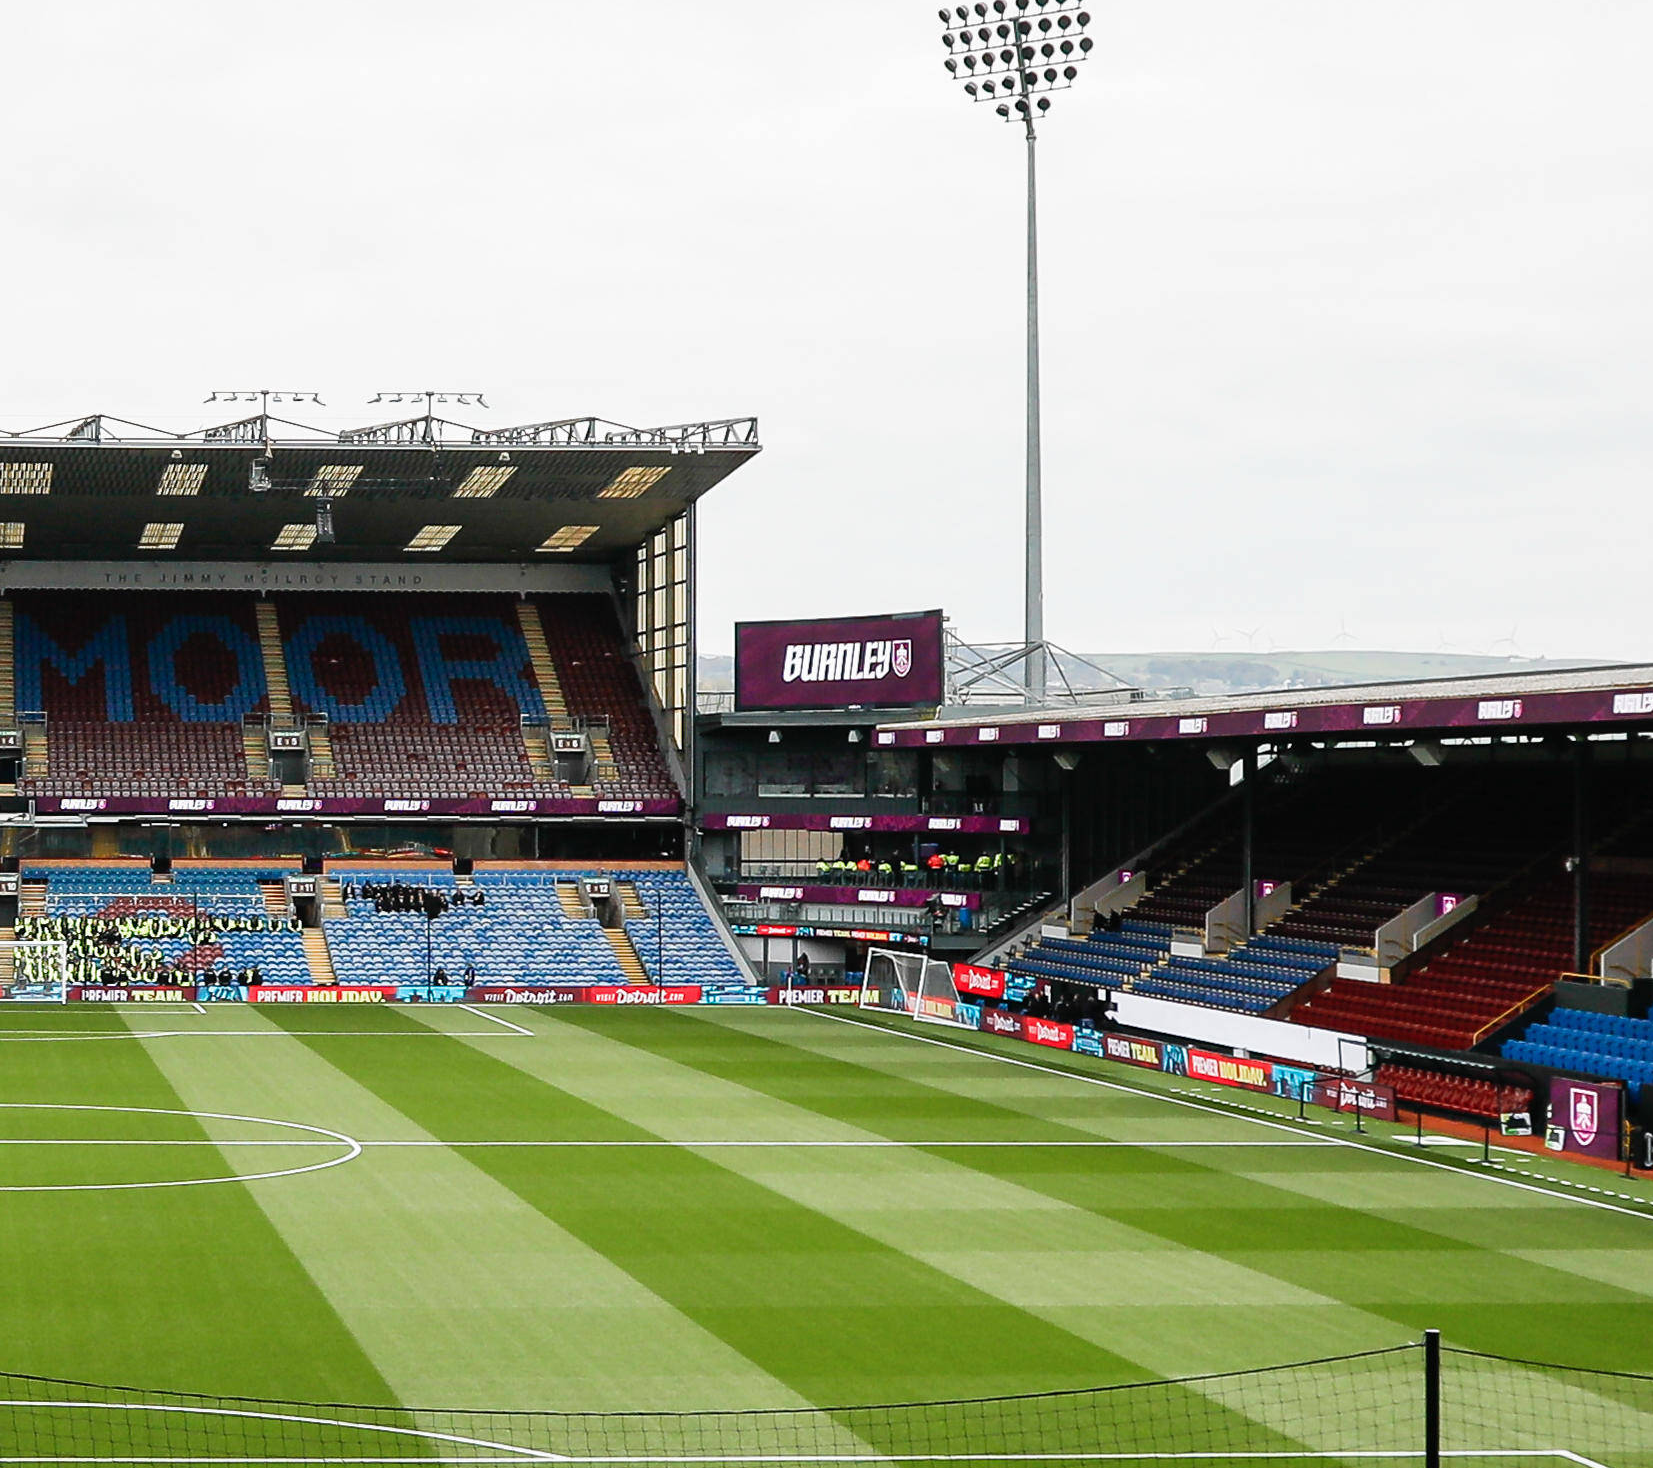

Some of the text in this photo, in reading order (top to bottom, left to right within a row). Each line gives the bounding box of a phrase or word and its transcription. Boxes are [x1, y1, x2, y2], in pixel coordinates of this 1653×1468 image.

[105, 573, 423, 585] THE JIMMY McILROY STAND
[783, 641, 891, 682] BURNLEY
[82, 989, 127, 1001] PREMIER
[257, 990, 303, 1002] PREMIER
[779, 990, 824, 1004] PREMIER
